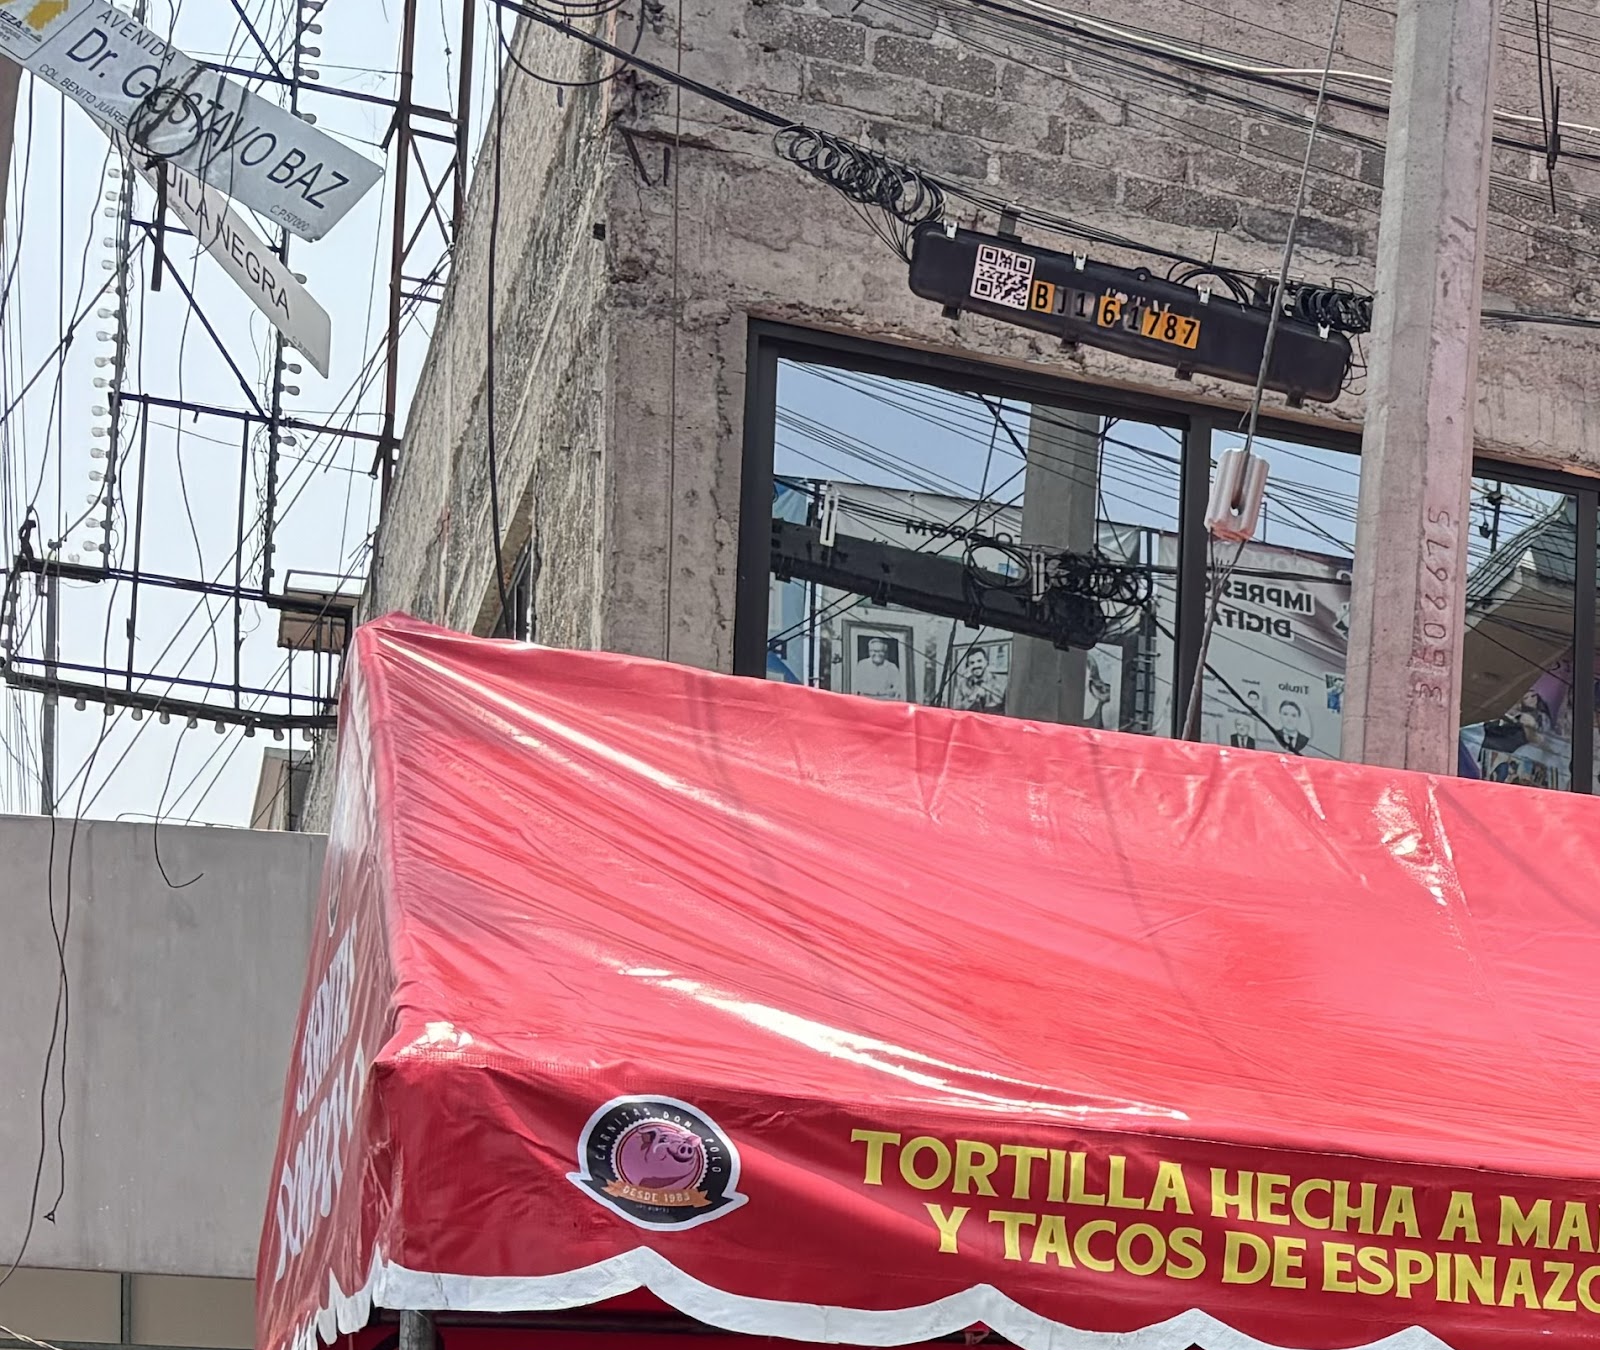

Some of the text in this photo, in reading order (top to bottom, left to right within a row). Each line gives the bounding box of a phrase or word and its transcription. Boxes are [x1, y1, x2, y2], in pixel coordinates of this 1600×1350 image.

[96, 9, 176, 66] AVENIDA
[60, 75, 97, 107] BENITO
[65, 26, 350, 210] Dr. GUSTAVO BAZ
[215, 212, 291, 322] NEGRA
[595, 1107, 652, 1161] CARNITAS
[663, 1110, 693, 1129] DON
[622, 1184, 658, 1203] DESDE
[850, 1128, 1194, 1216] TORTILLA
[1209, 1169, 1431, 1240] HECHA
[1440, 1194, 1482, 1245] A
[924, 1203, 968, 1255] Y
[988, 1210, 1205, 1281] TACOS
[1221, 1228, 1310, 1291] DE
